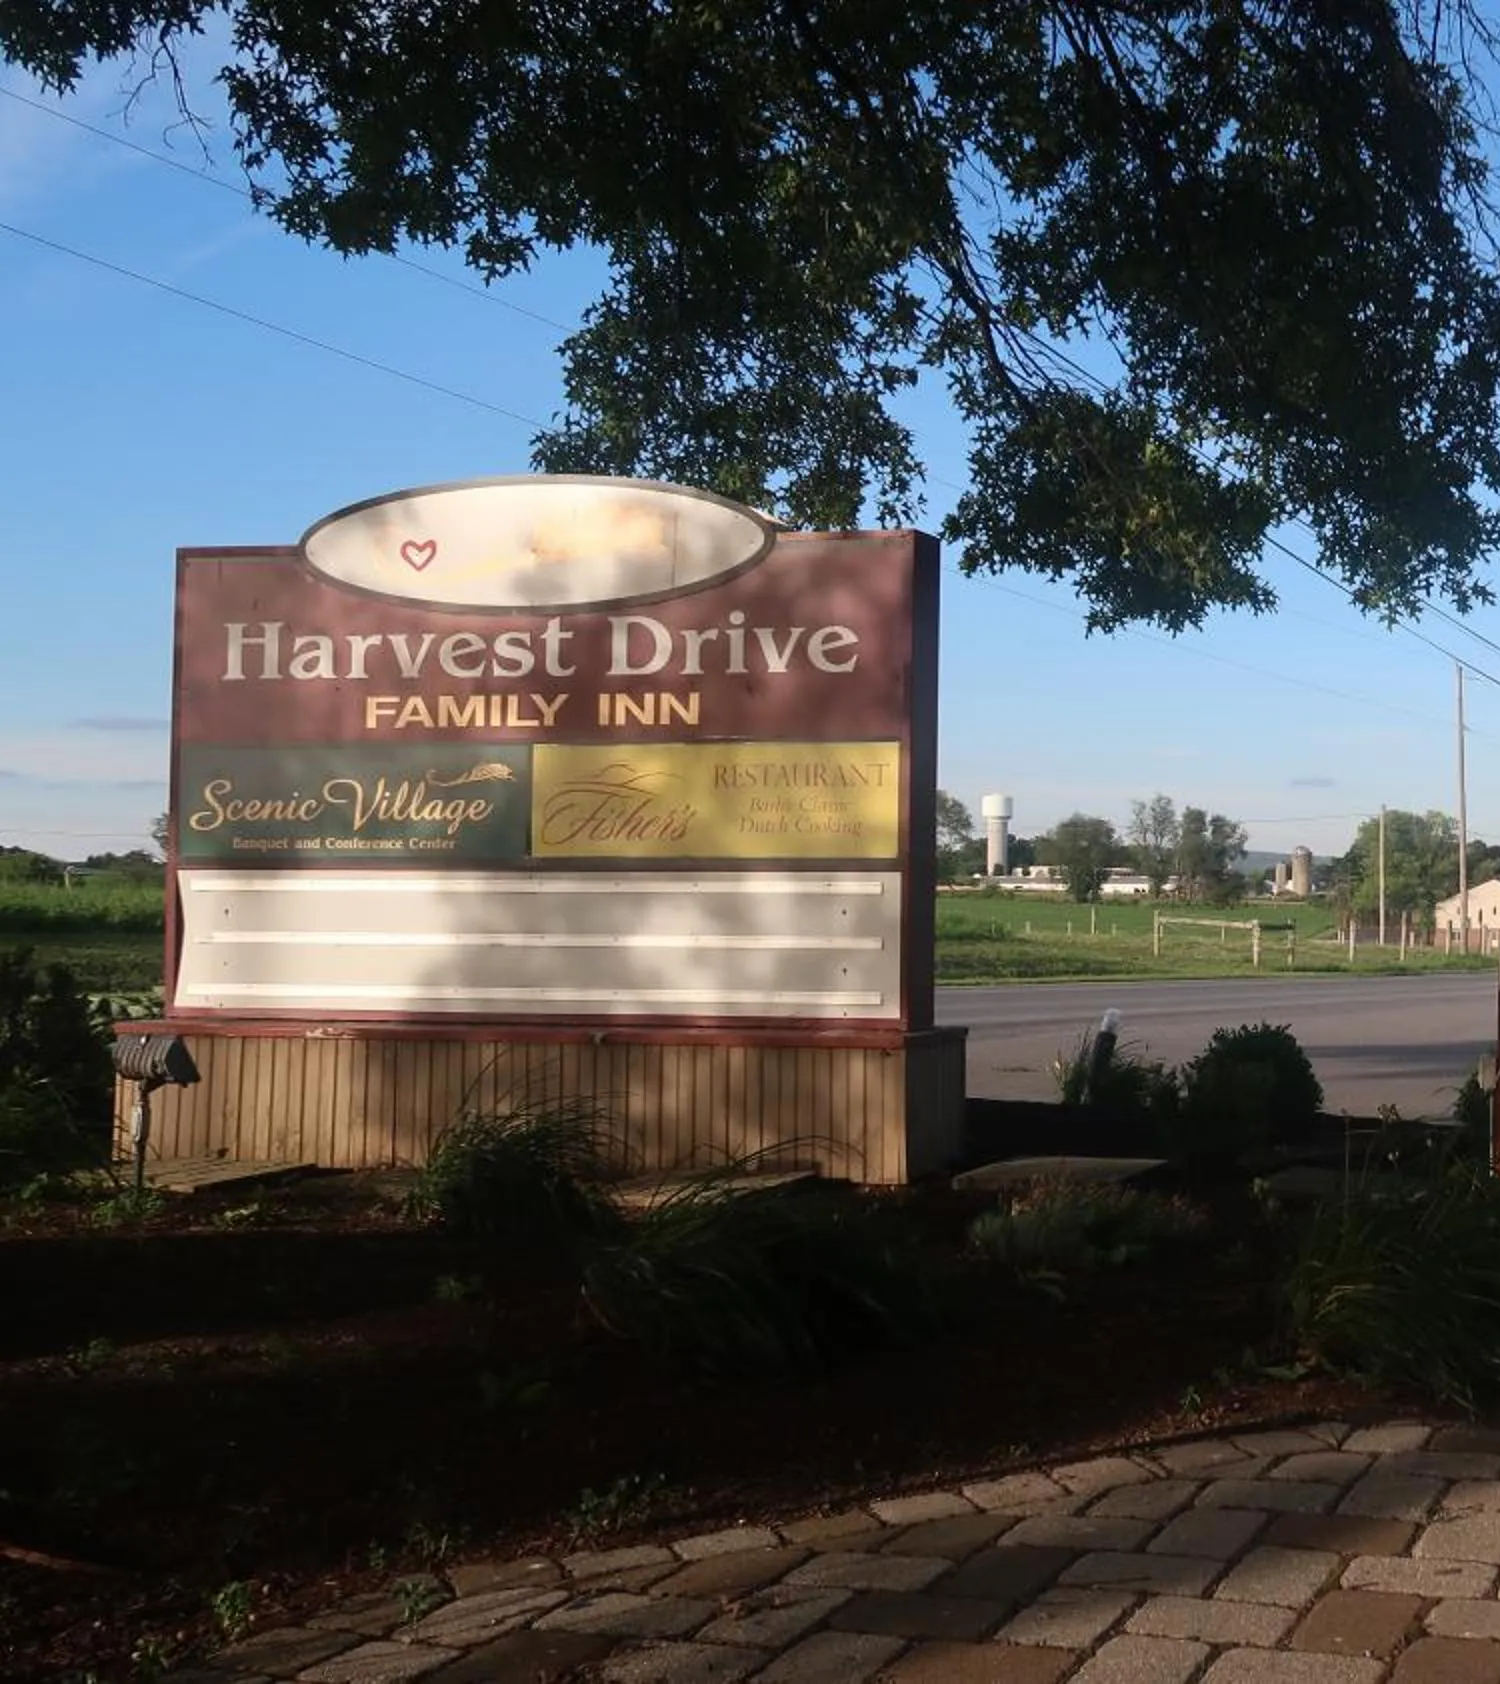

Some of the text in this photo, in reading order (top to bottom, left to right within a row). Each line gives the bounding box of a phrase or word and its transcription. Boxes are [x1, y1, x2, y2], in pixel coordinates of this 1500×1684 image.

[221, 610, 859, 680] Harvest Drive
[365, 691, 700, 729] FAMILY INN
[713, 763, 890, 790] RESTAURANT
[189, 777, 494, 836] Scenic Village
[232, 836, 457, 853] Banquet and Conference Center
